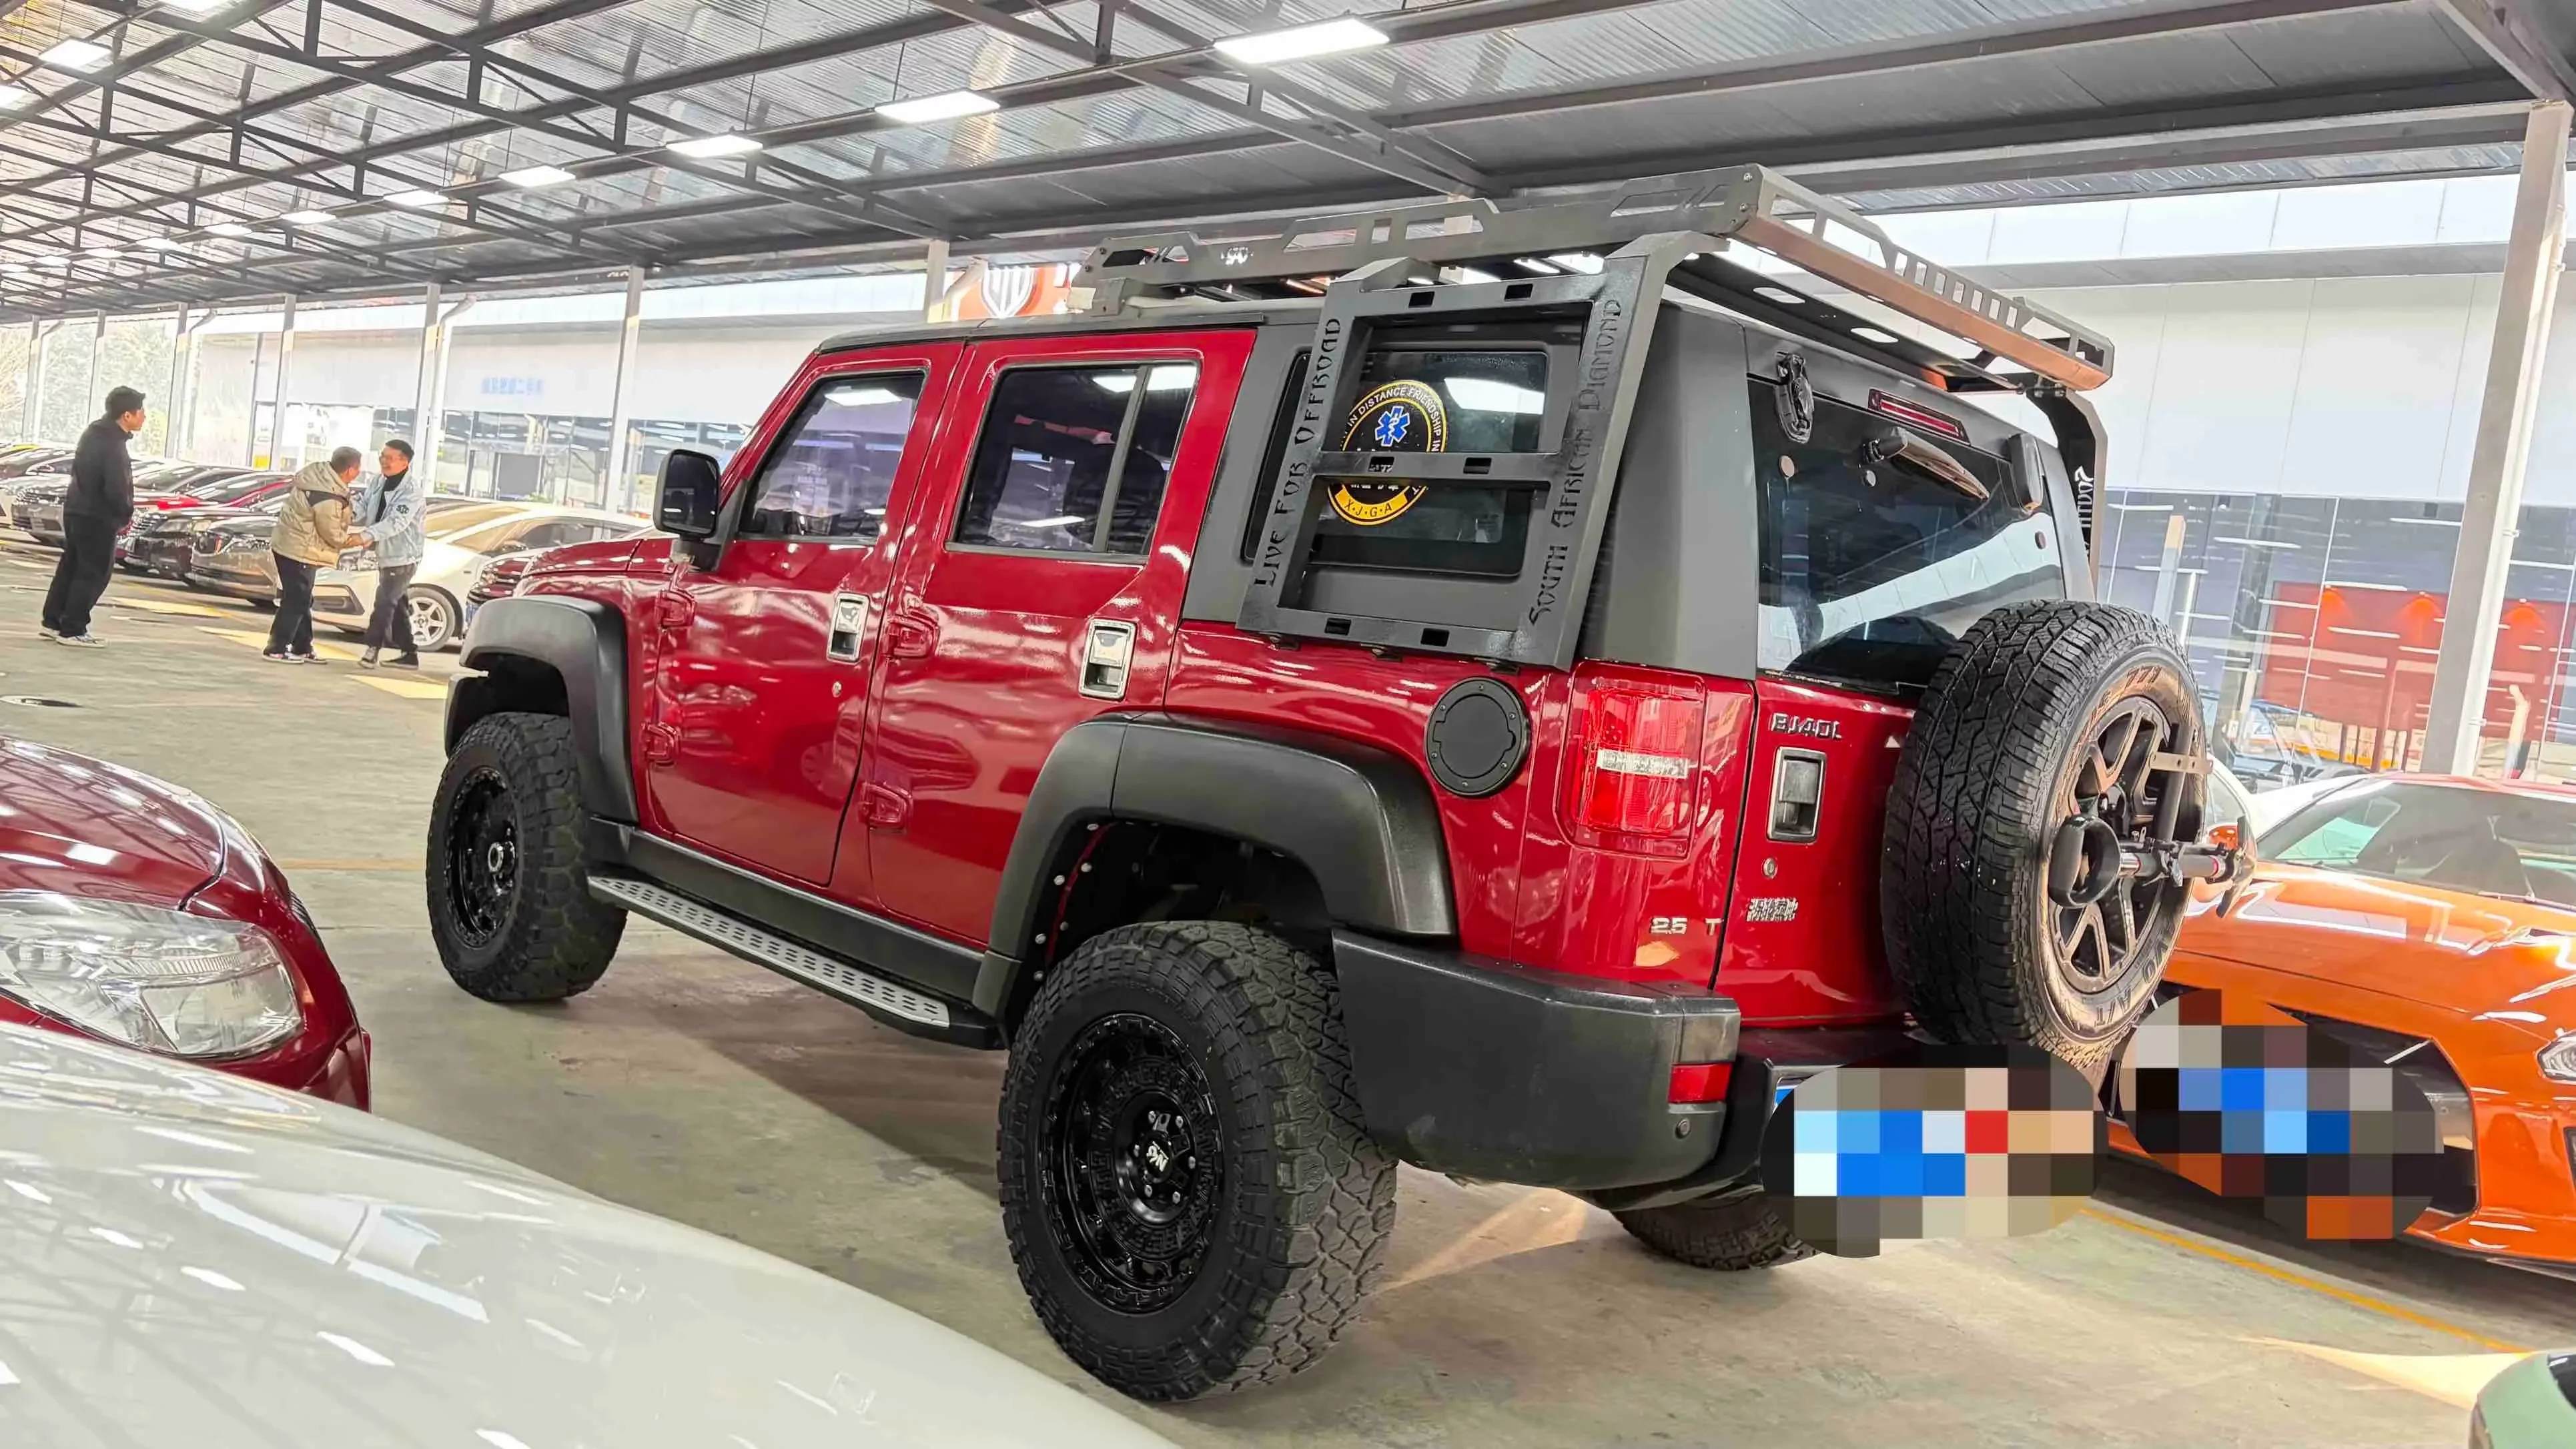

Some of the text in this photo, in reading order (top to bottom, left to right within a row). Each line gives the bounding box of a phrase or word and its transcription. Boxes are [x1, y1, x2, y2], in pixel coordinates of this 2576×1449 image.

[1358, 387, 1406, 416] DISTANCE
[1407, 388, 1442, 438] FRIENDSHIP
[1771, 712, 1842, 739] BJ40L
[1705, 917, 1723, 935] T
